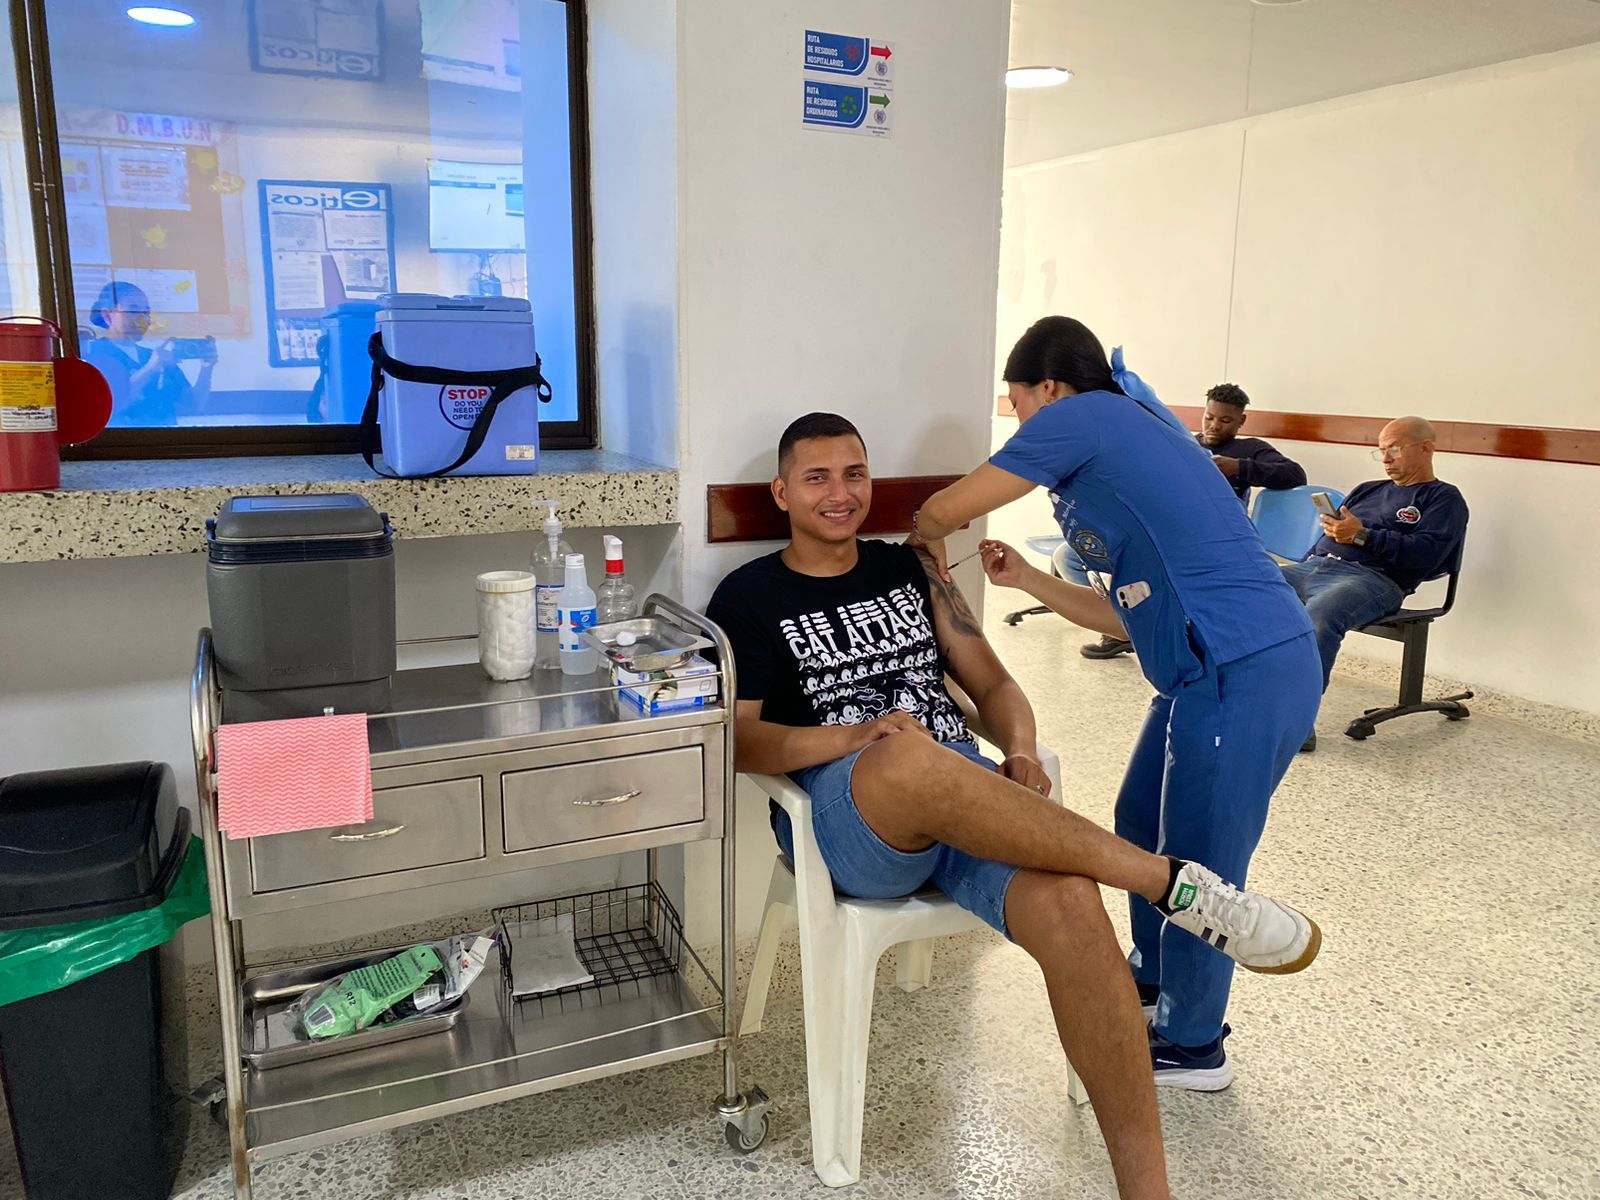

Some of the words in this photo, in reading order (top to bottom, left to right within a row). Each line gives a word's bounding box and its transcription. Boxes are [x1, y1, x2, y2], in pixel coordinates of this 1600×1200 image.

[807, 34, 820, 43] RUTA
[807, 45, 814, 53] DE
[814, 46, 838, 56] RESIDUOS
[807, 55, 844, 67] HOSPITALARIOS
[806, 86, 819, 94] RUTA
[806, 96, 813, 104] DE
[813, 97, 837, 107] RESIDUOS
[448, 389, 488, 400] STOP
[789, 628, 838, 660] CAT
[844, 598, 929, 648] ATTACK
